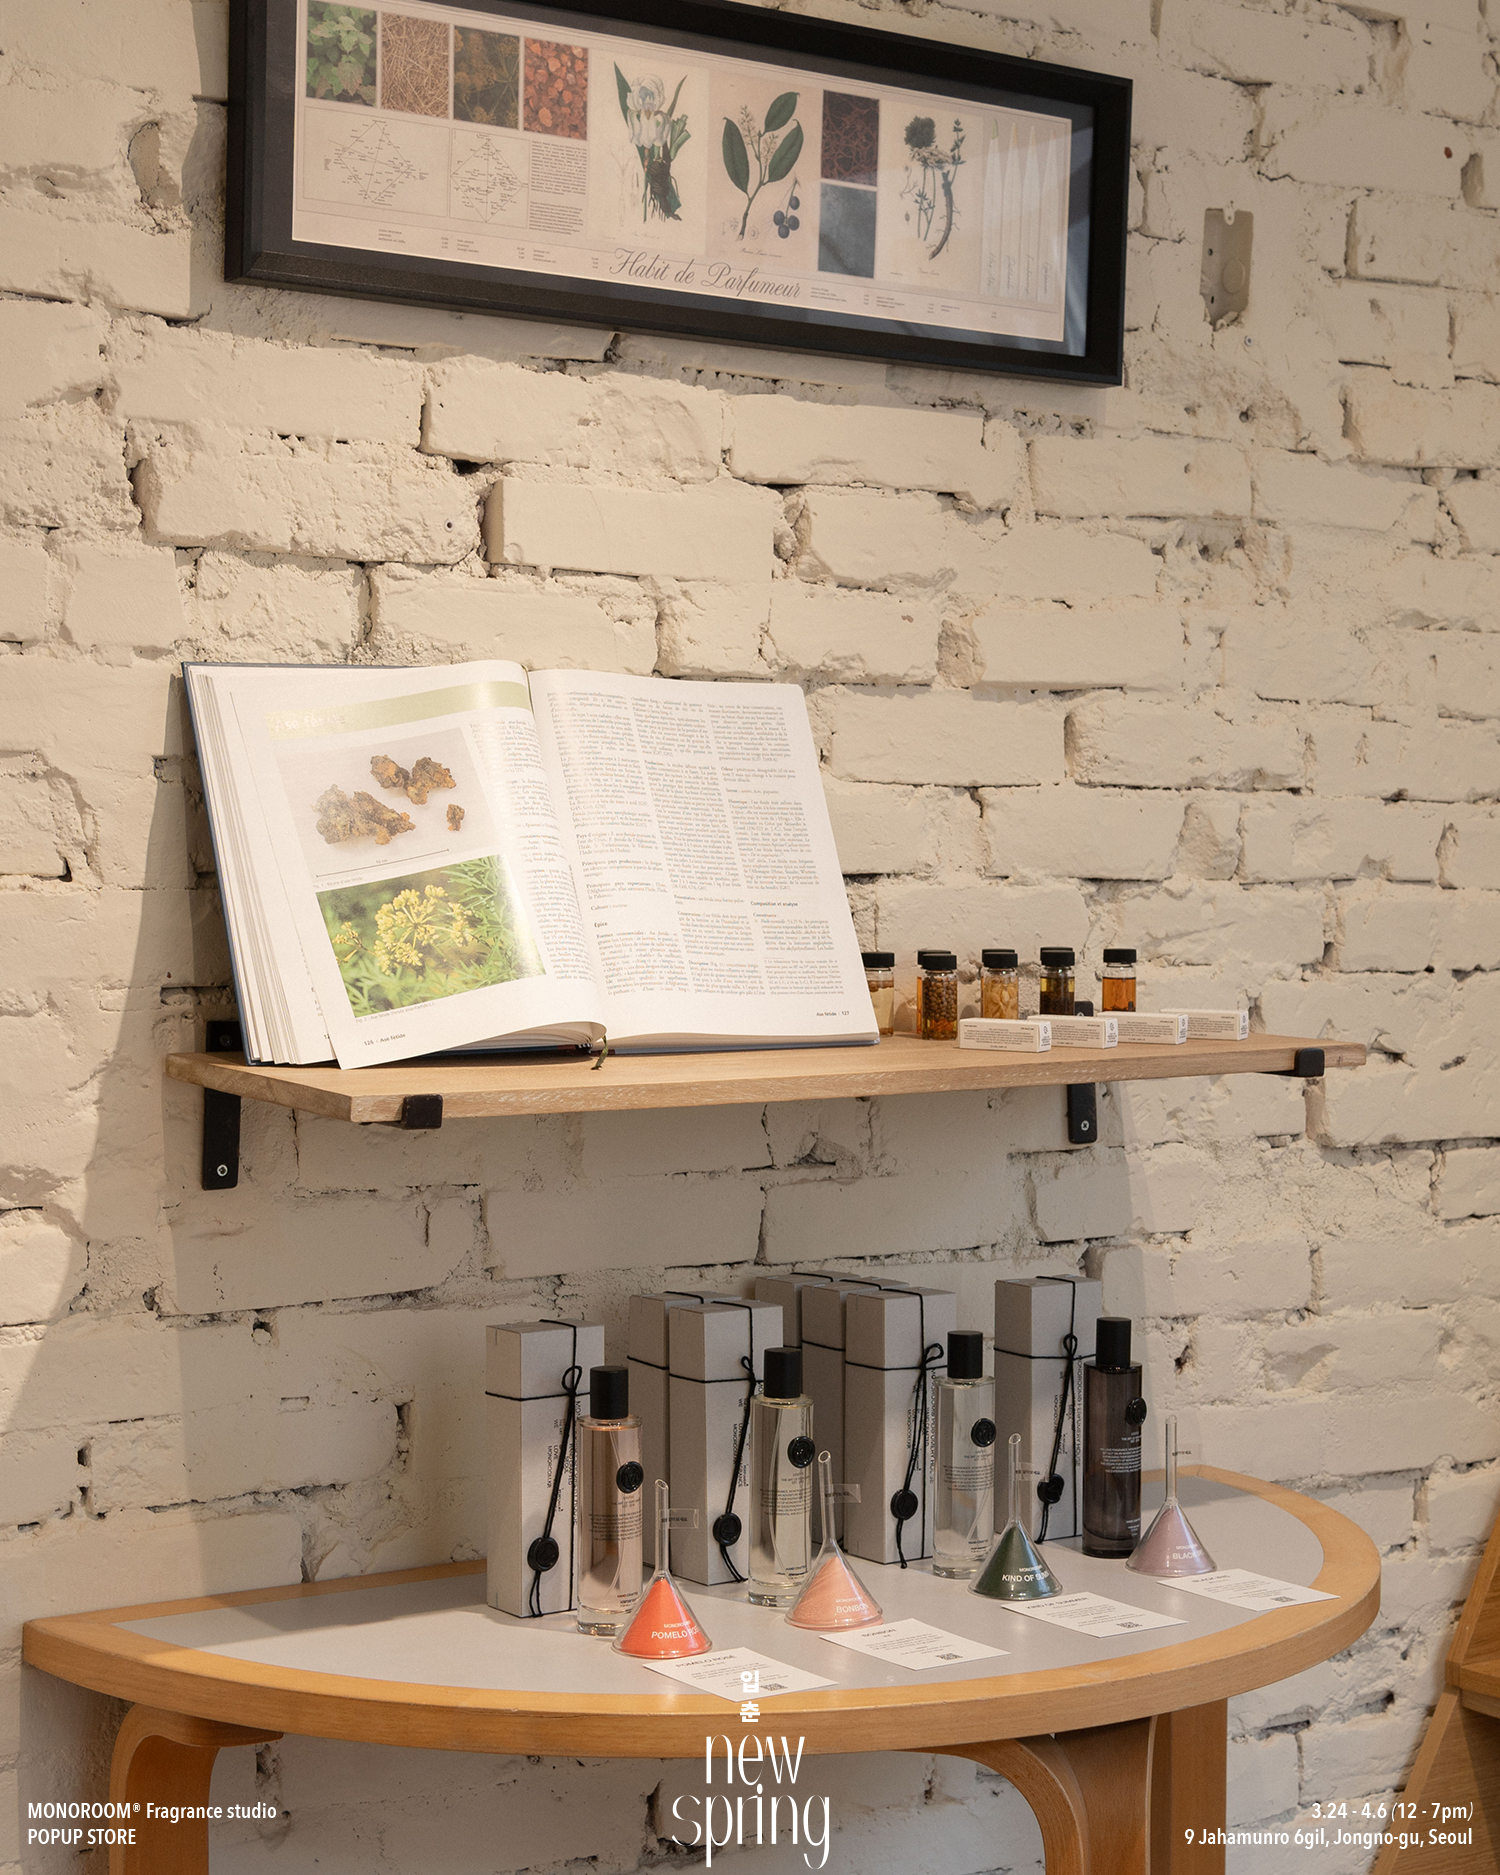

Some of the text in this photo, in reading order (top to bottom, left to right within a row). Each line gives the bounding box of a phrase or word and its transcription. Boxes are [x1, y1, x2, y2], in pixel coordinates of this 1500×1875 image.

[609, 247, 671, 281] Habit
[674, 258, 695, 284] de
[700, 262, 801, 298] Parfumeur
[1172, 1551, 1197, 1561] BLACK
[1002, 1573, 1022, 1582] KIND
[1023, 1573, 1035, 1582] OF
[651, 1629, 688, 1640] POMELO
